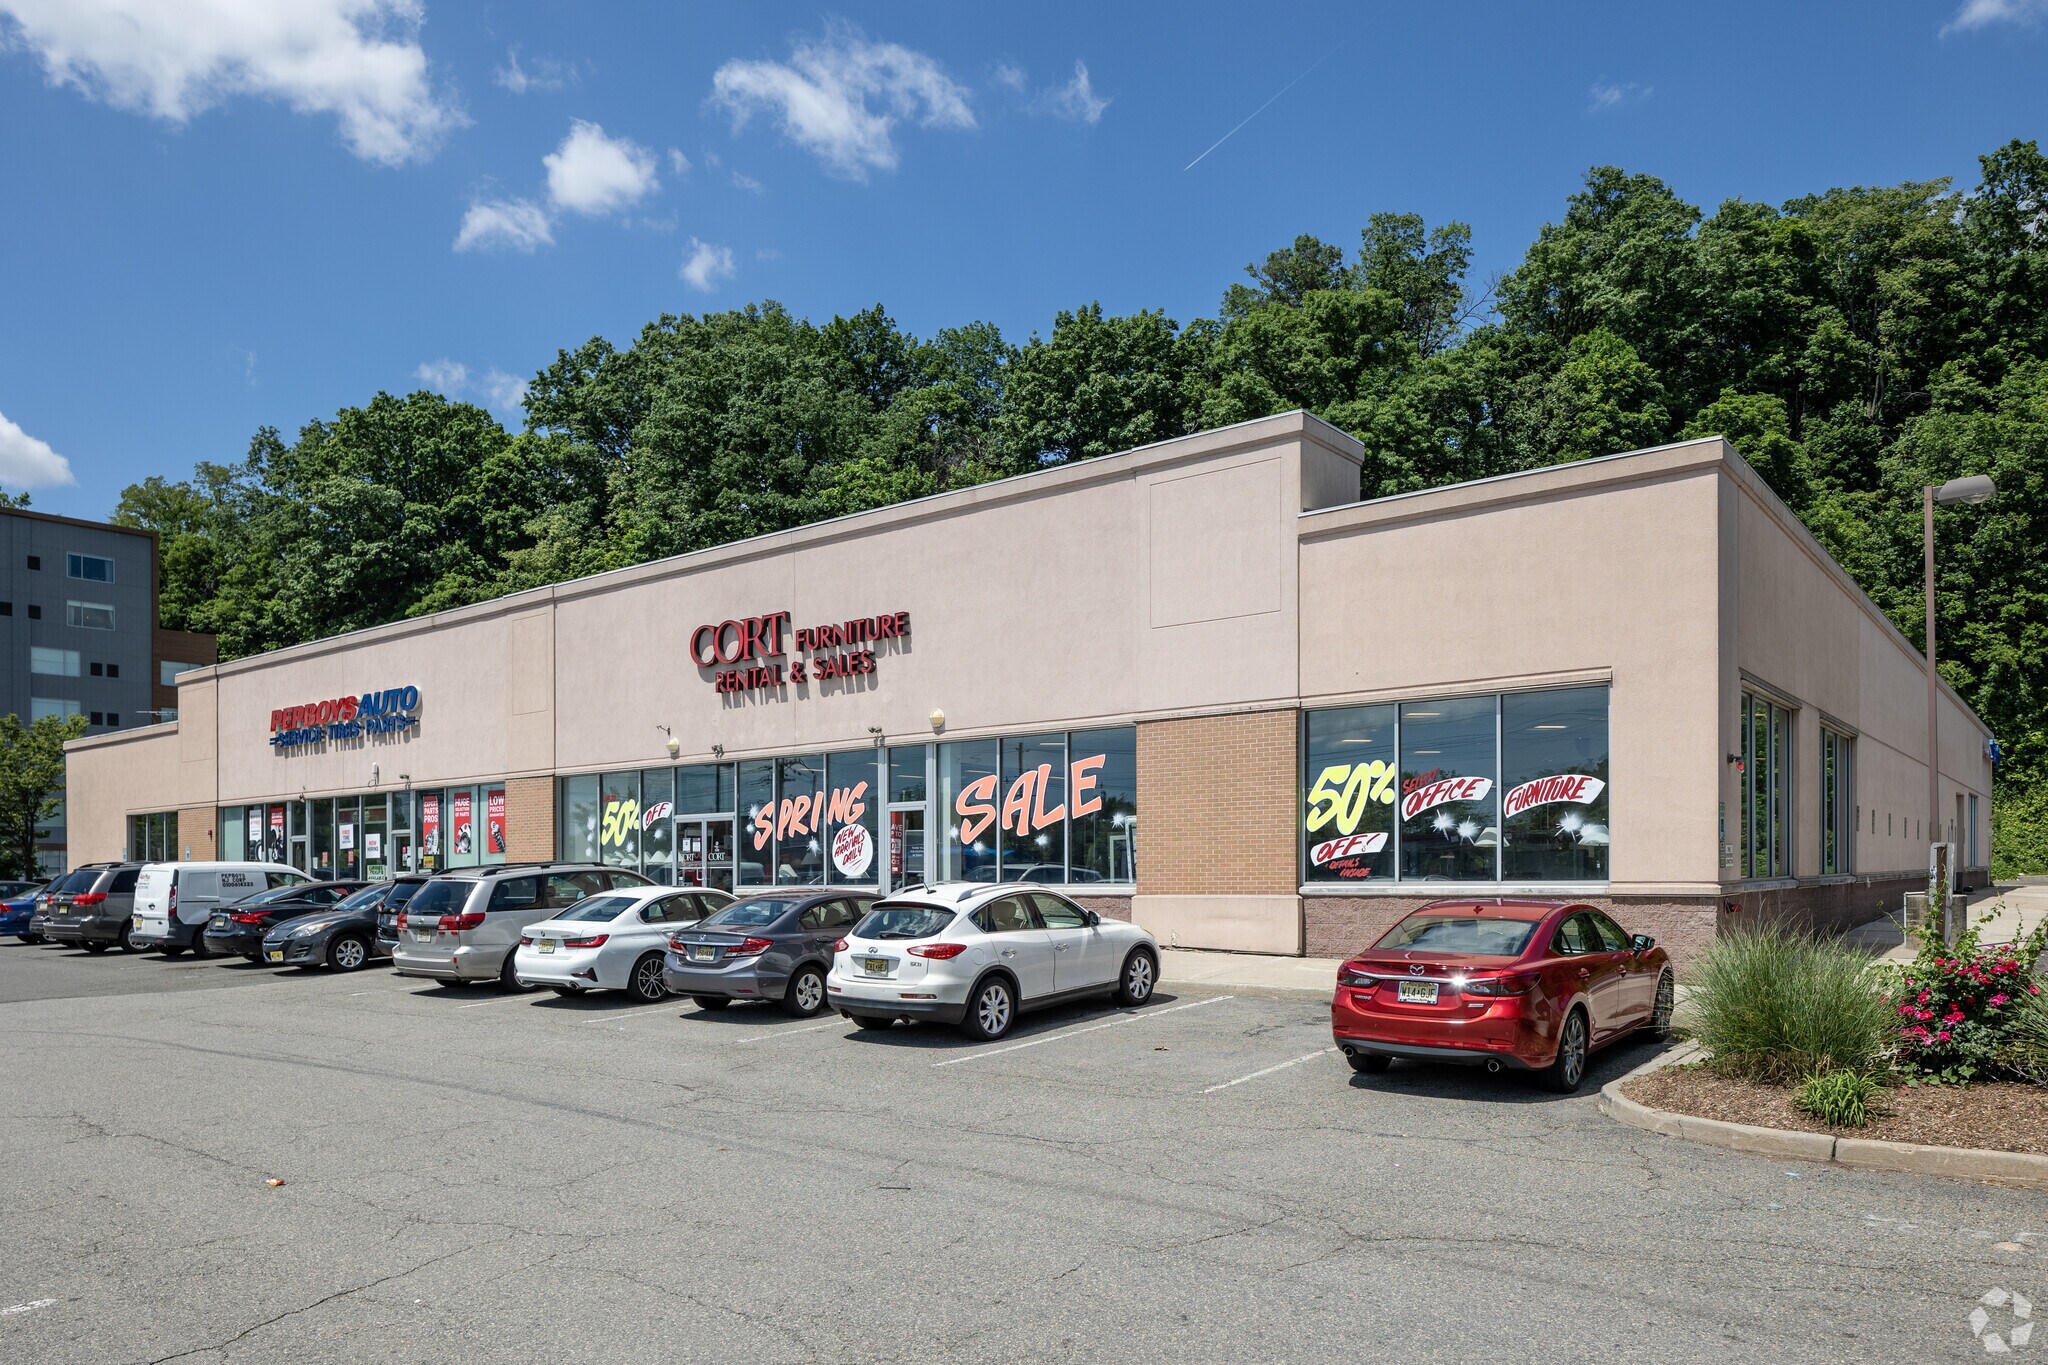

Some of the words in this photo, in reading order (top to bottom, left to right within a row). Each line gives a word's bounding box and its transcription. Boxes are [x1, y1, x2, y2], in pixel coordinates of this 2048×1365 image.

[690, 611, 787, 667] CORT
[795, 611, 909, 652] FURNITURE
[715, 664, 785, 694] RENTAL
[789, 661, 807, 684] &
[813, 650, 876, 680] SALES
[279, 727, 323, 747] SERVICE
[328, 721, 360, 740] TIRES
[366, 714, 406, 735] PARTS
[1402, 767, 1440, 795] SELECT
[454, 798, 470, 807] HUGE
[489, 795, 505, 806] LOW
[955, 754, 1106, 845] SALE
[1306, 759, 1396, 836] 50%
[1406, 778, 1485, 817] OFFICE
[1505, 775, 1593, 815] FURNITURE
[423, 807, 439, 815] PARTS
[423, 815, 439, 823] PROS
[601, 798, 640, 847] 50%
[645, 802, 669, 827] OFF
[753, 781, 869, 851] SPRING
[834, 829, 865, 858] ARRIVALS
[836, 824, 858, 845] NEW
[708, 852, 725, 861] CORT
[843, 843, 863, 866] DAILY
